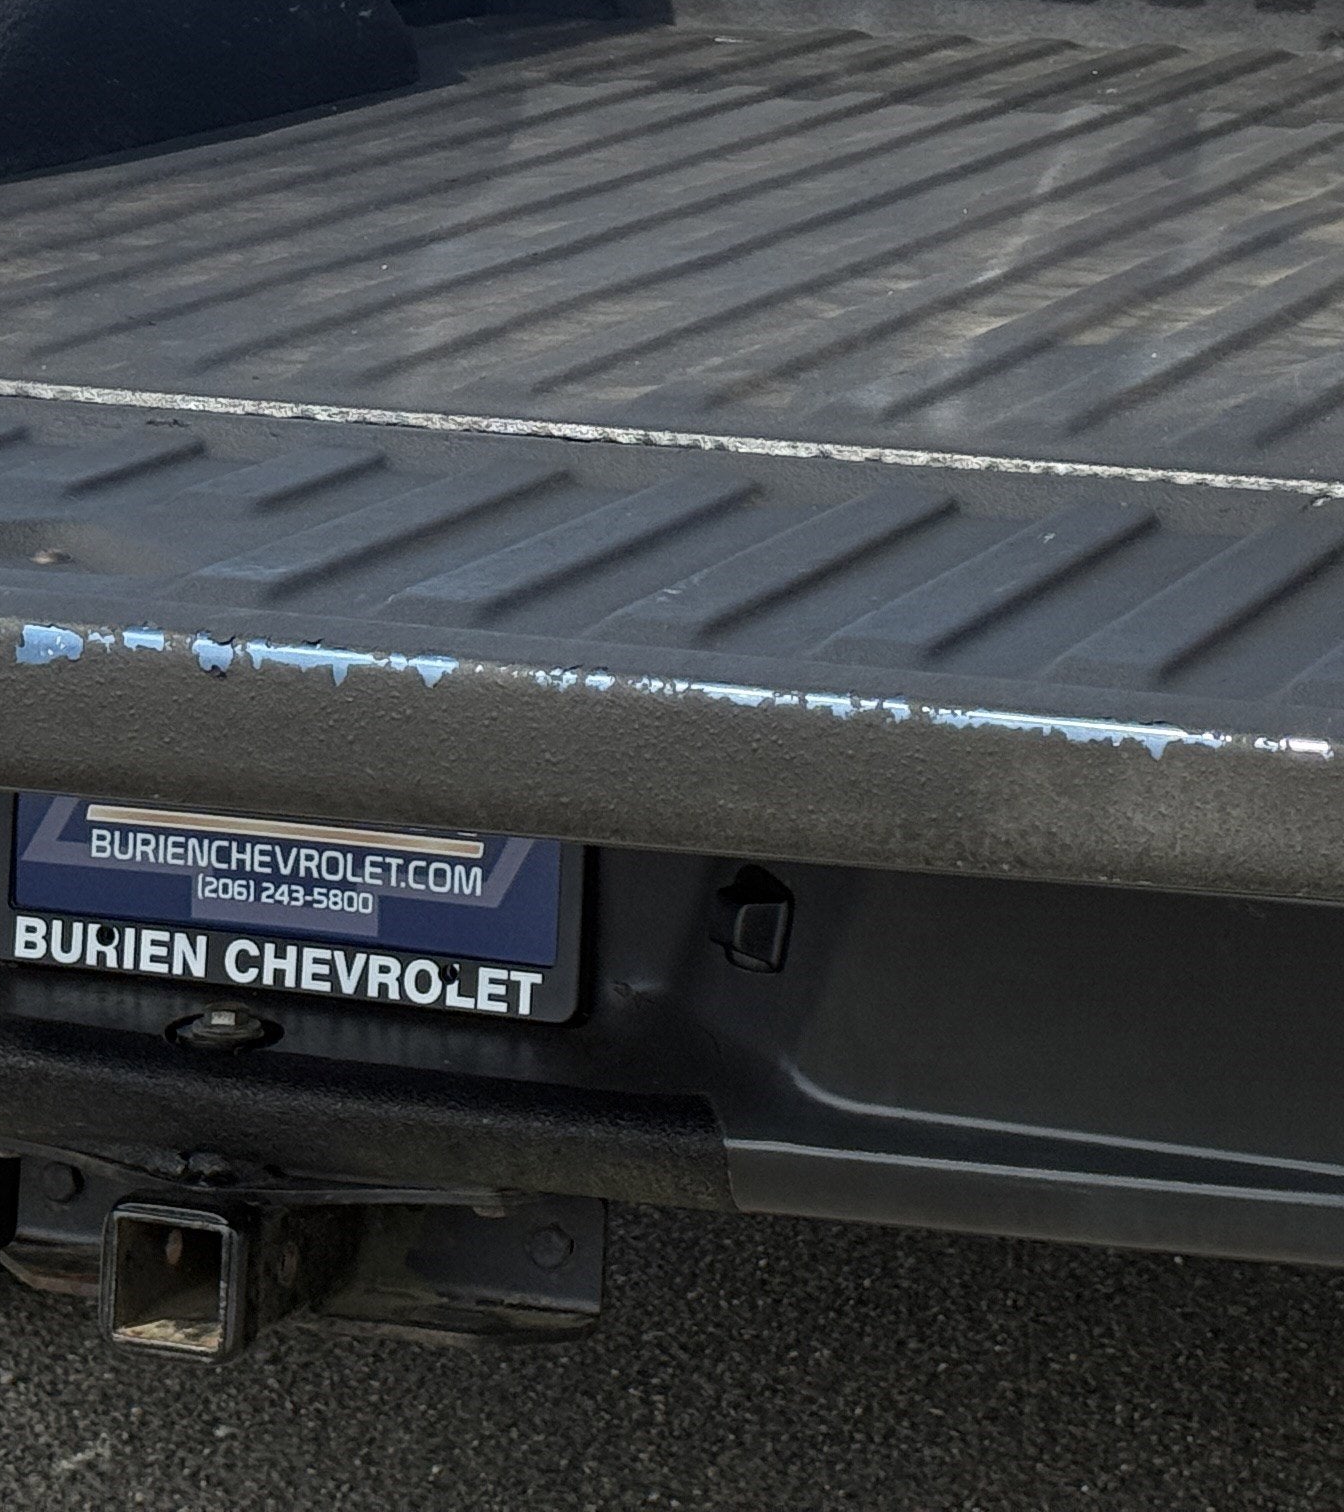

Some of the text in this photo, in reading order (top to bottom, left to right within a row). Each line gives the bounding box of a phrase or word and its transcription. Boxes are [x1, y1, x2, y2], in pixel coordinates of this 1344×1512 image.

[89, 828, 484, 898] BURIENCHEVROLET.COM
[196, 875, 374, 915] (206) 243-5800
[14, 915, 543, 1016] BURIEN CHEVROLET
